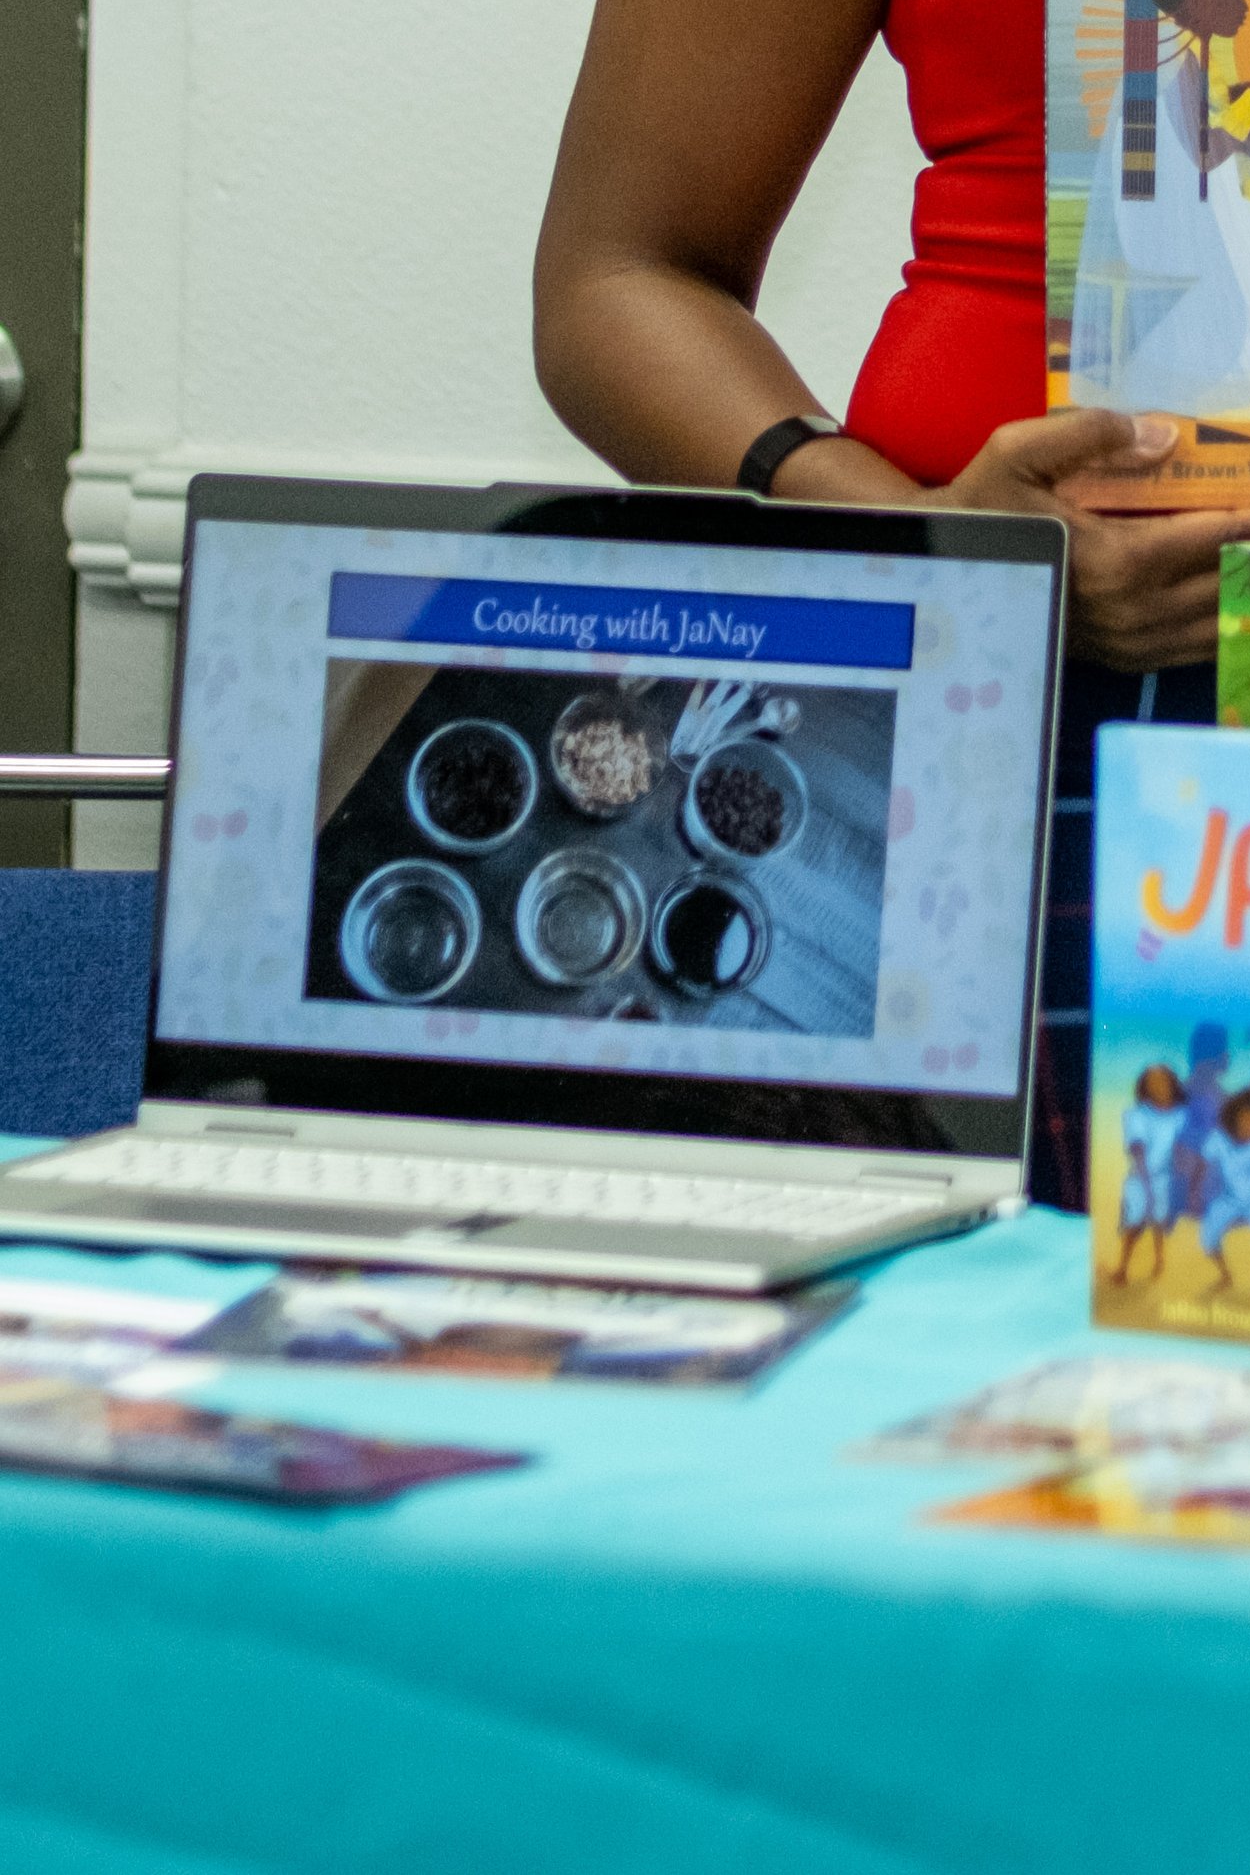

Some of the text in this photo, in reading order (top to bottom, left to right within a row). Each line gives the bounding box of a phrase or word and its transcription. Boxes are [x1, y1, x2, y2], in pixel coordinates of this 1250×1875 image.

[472, 593, 767, 659] Cooking with JaNay
